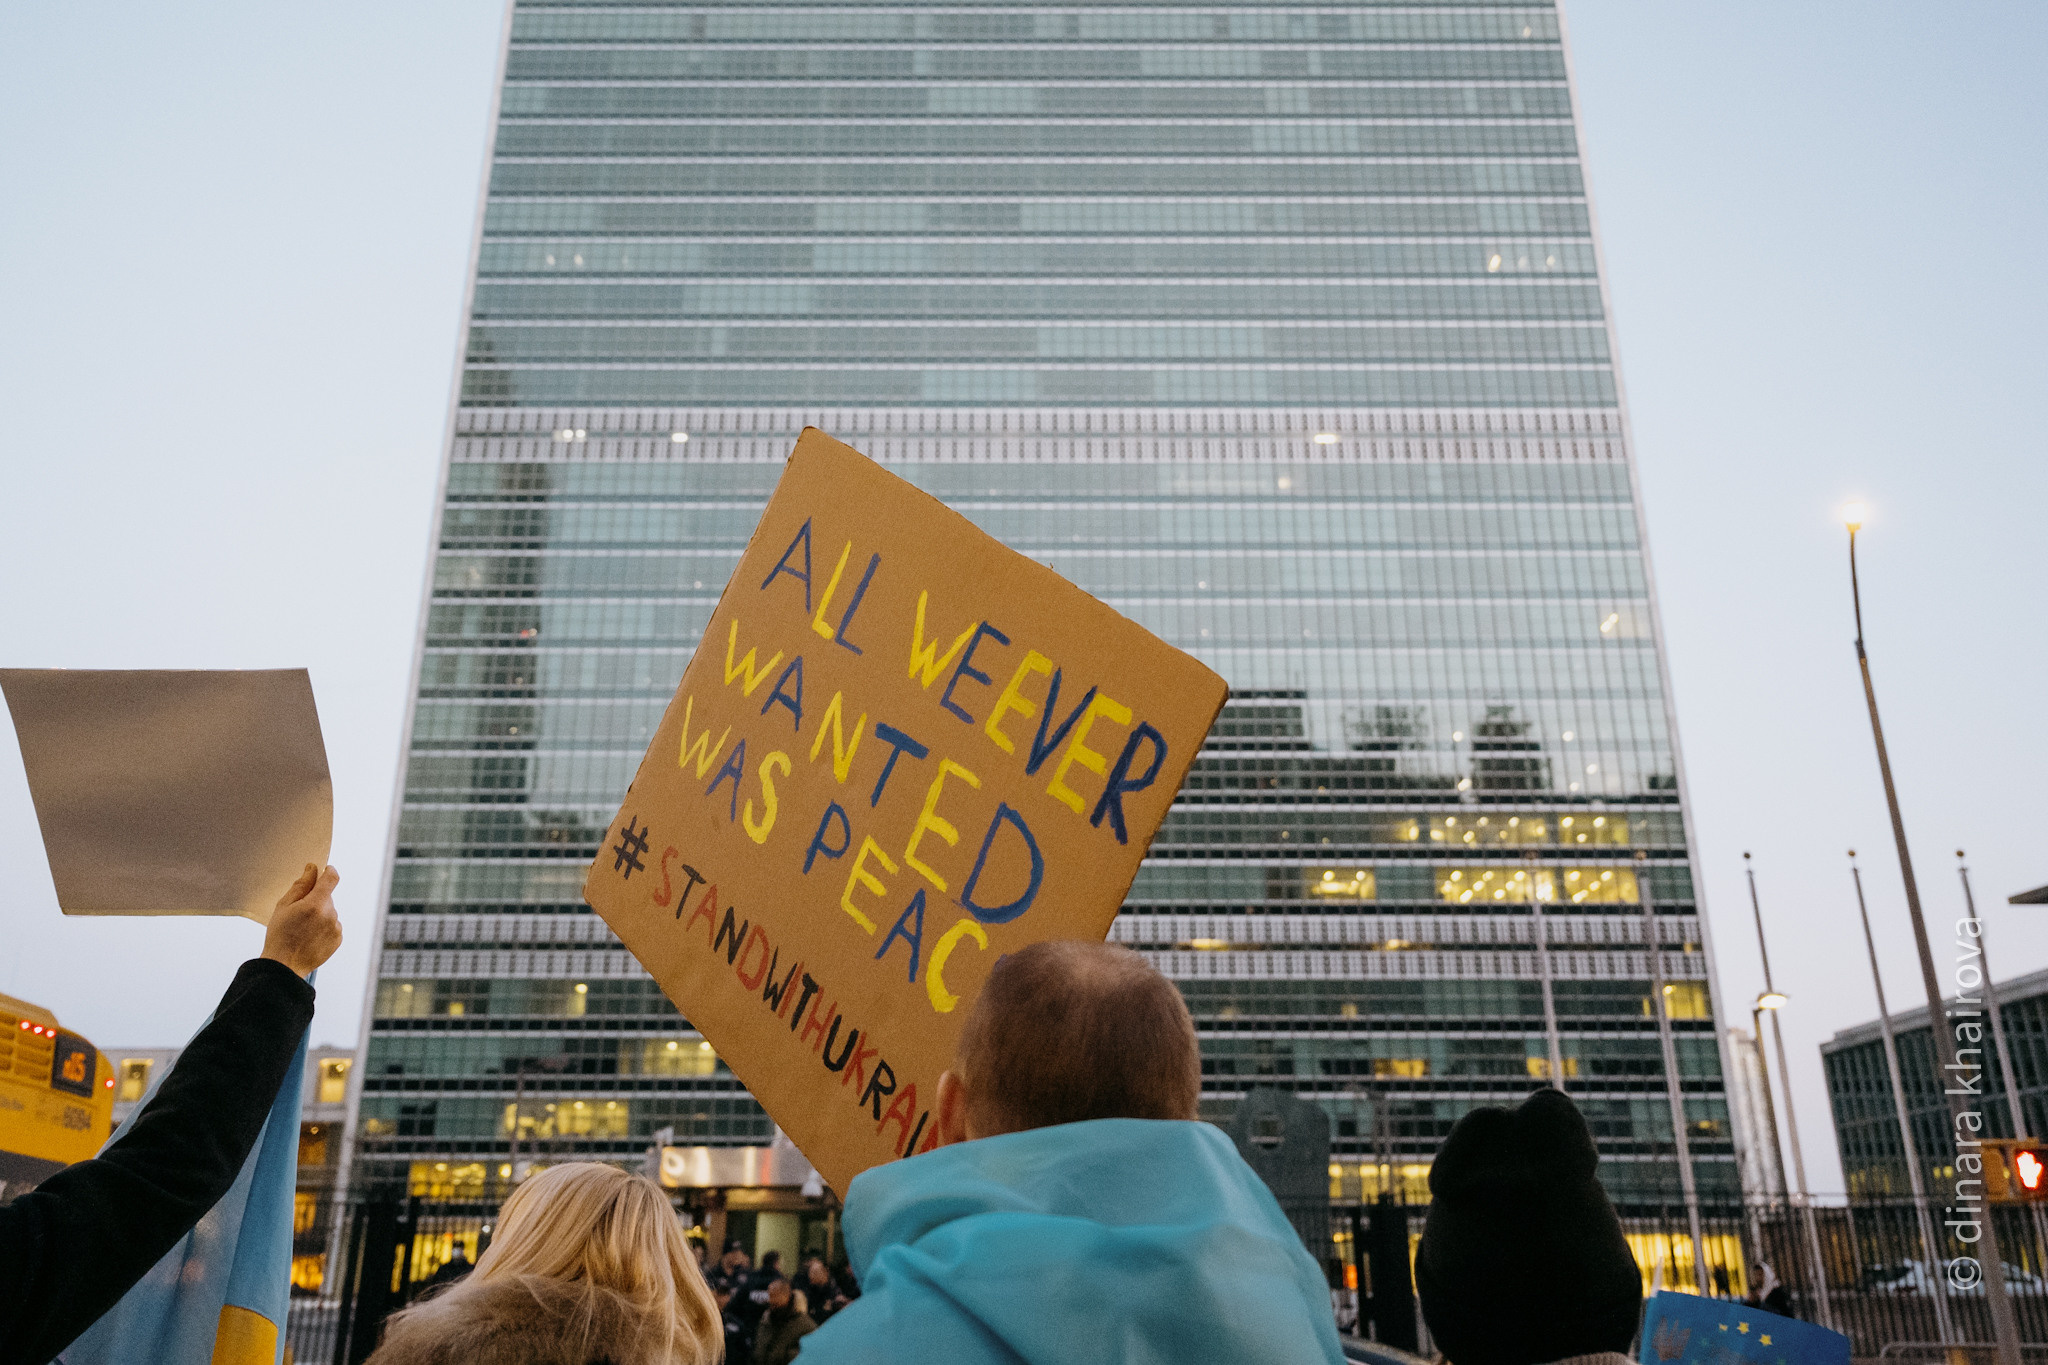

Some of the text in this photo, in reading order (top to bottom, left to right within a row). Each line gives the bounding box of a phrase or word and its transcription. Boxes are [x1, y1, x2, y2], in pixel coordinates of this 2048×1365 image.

[761, 516, 881, 656] ALL
[679, 695, 1008, 1013] WAS PEAC
[724, 618, 1045, 924] WANTED
